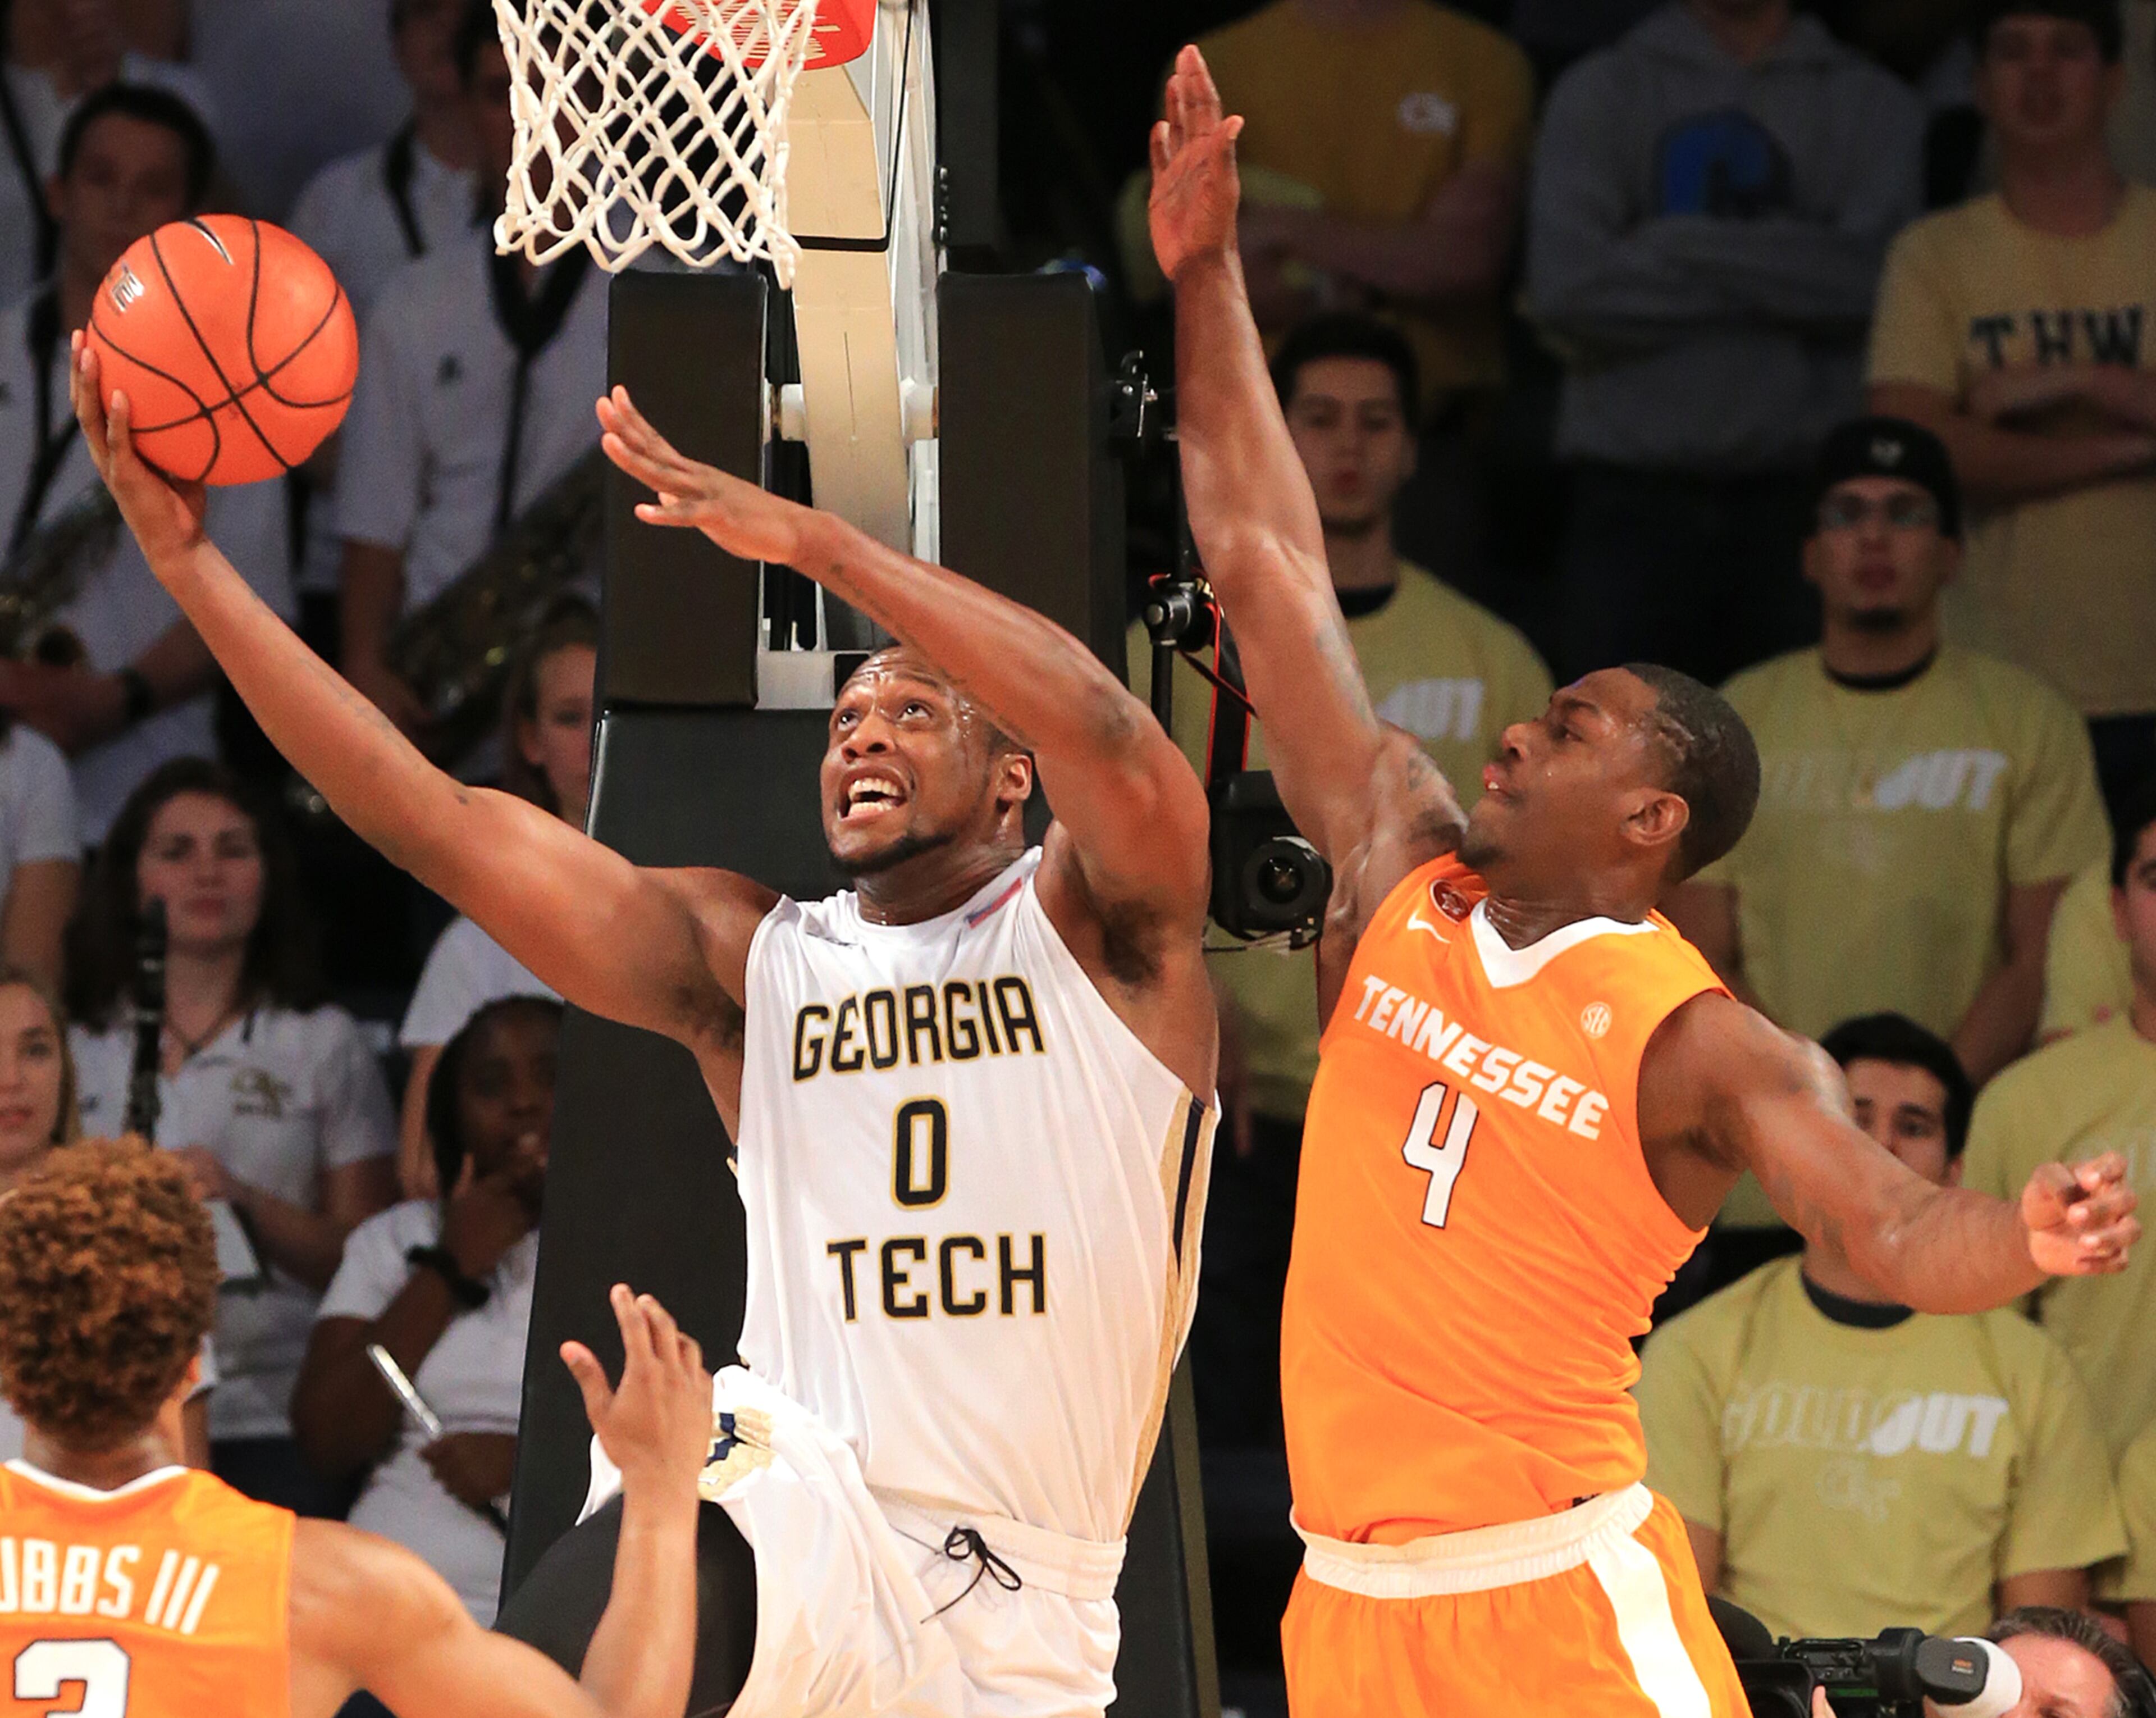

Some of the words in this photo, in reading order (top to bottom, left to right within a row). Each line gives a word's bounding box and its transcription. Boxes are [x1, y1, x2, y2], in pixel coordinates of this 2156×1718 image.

[793, 976, 1047, 1082] GEORGIA
[1354, 974, 1609, 1141] TENNESSEE
[890, 1095, 950, 1211] 0
[1401, 1081, 1479, 1229] 4
[826, 1232, 1047, 1323] TECH
[143, 1548, 220, 1635] III
